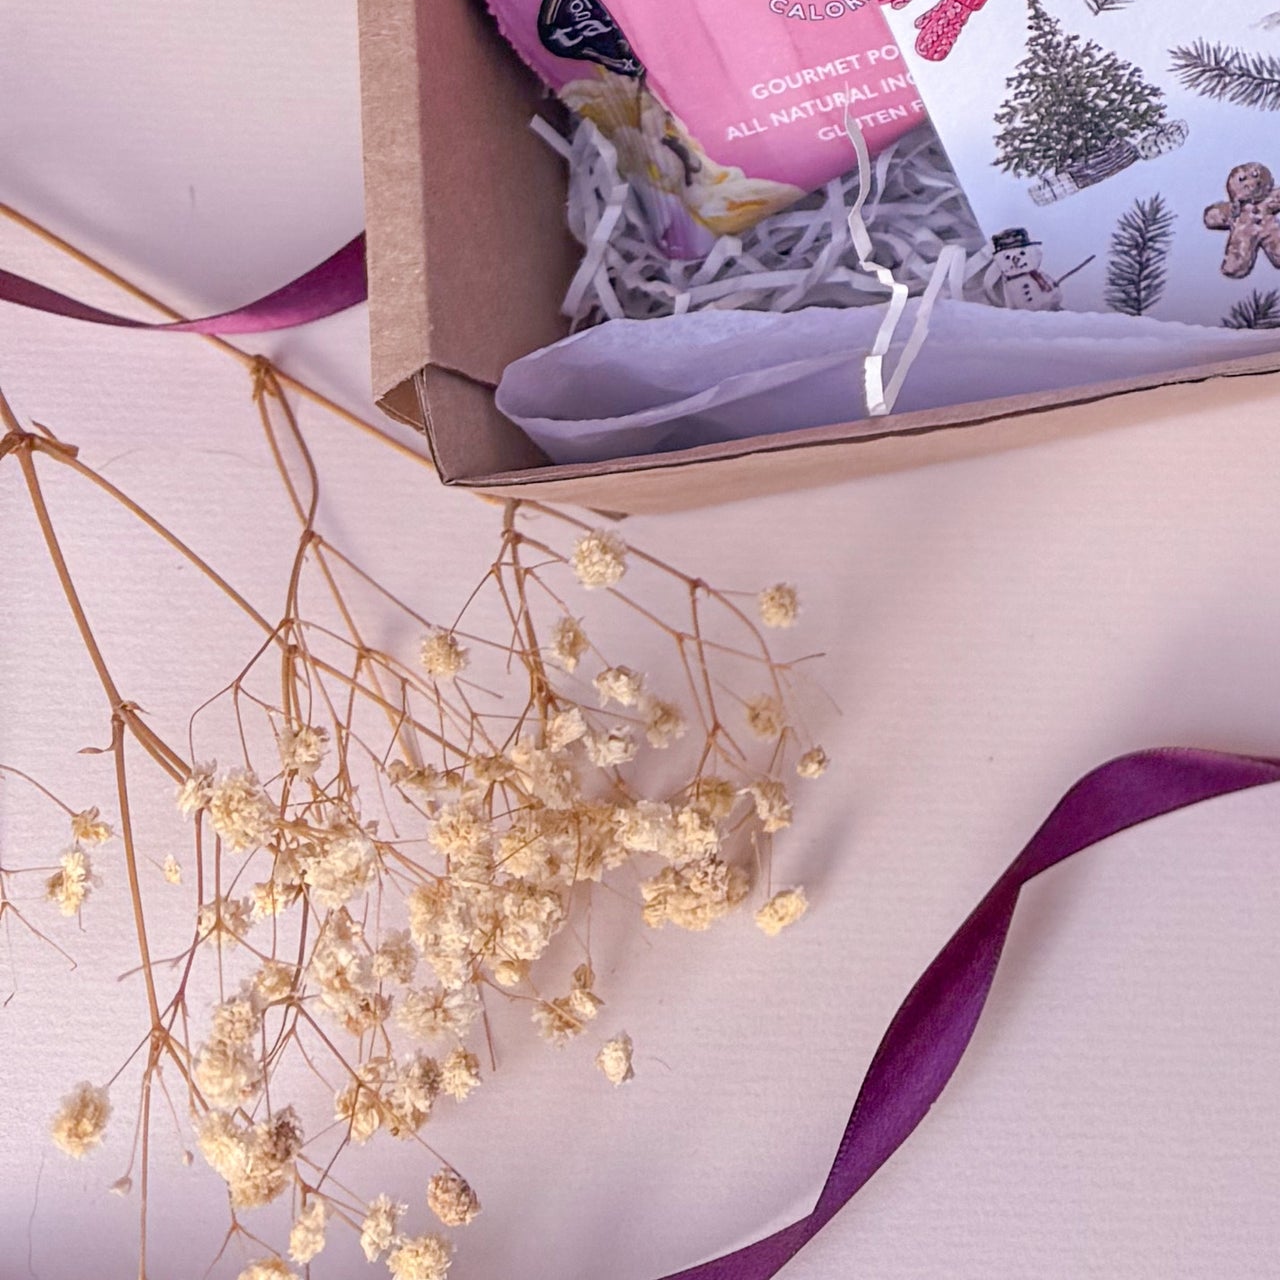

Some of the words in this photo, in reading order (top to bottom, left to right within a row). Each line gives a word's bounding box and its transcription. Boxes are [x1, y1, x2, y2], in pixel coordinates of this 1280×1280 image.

[751, 54, 860, 100] GOURMET
[726, 118, 768, 141] ALL
[770, 83, 879, 128] NATURAL
